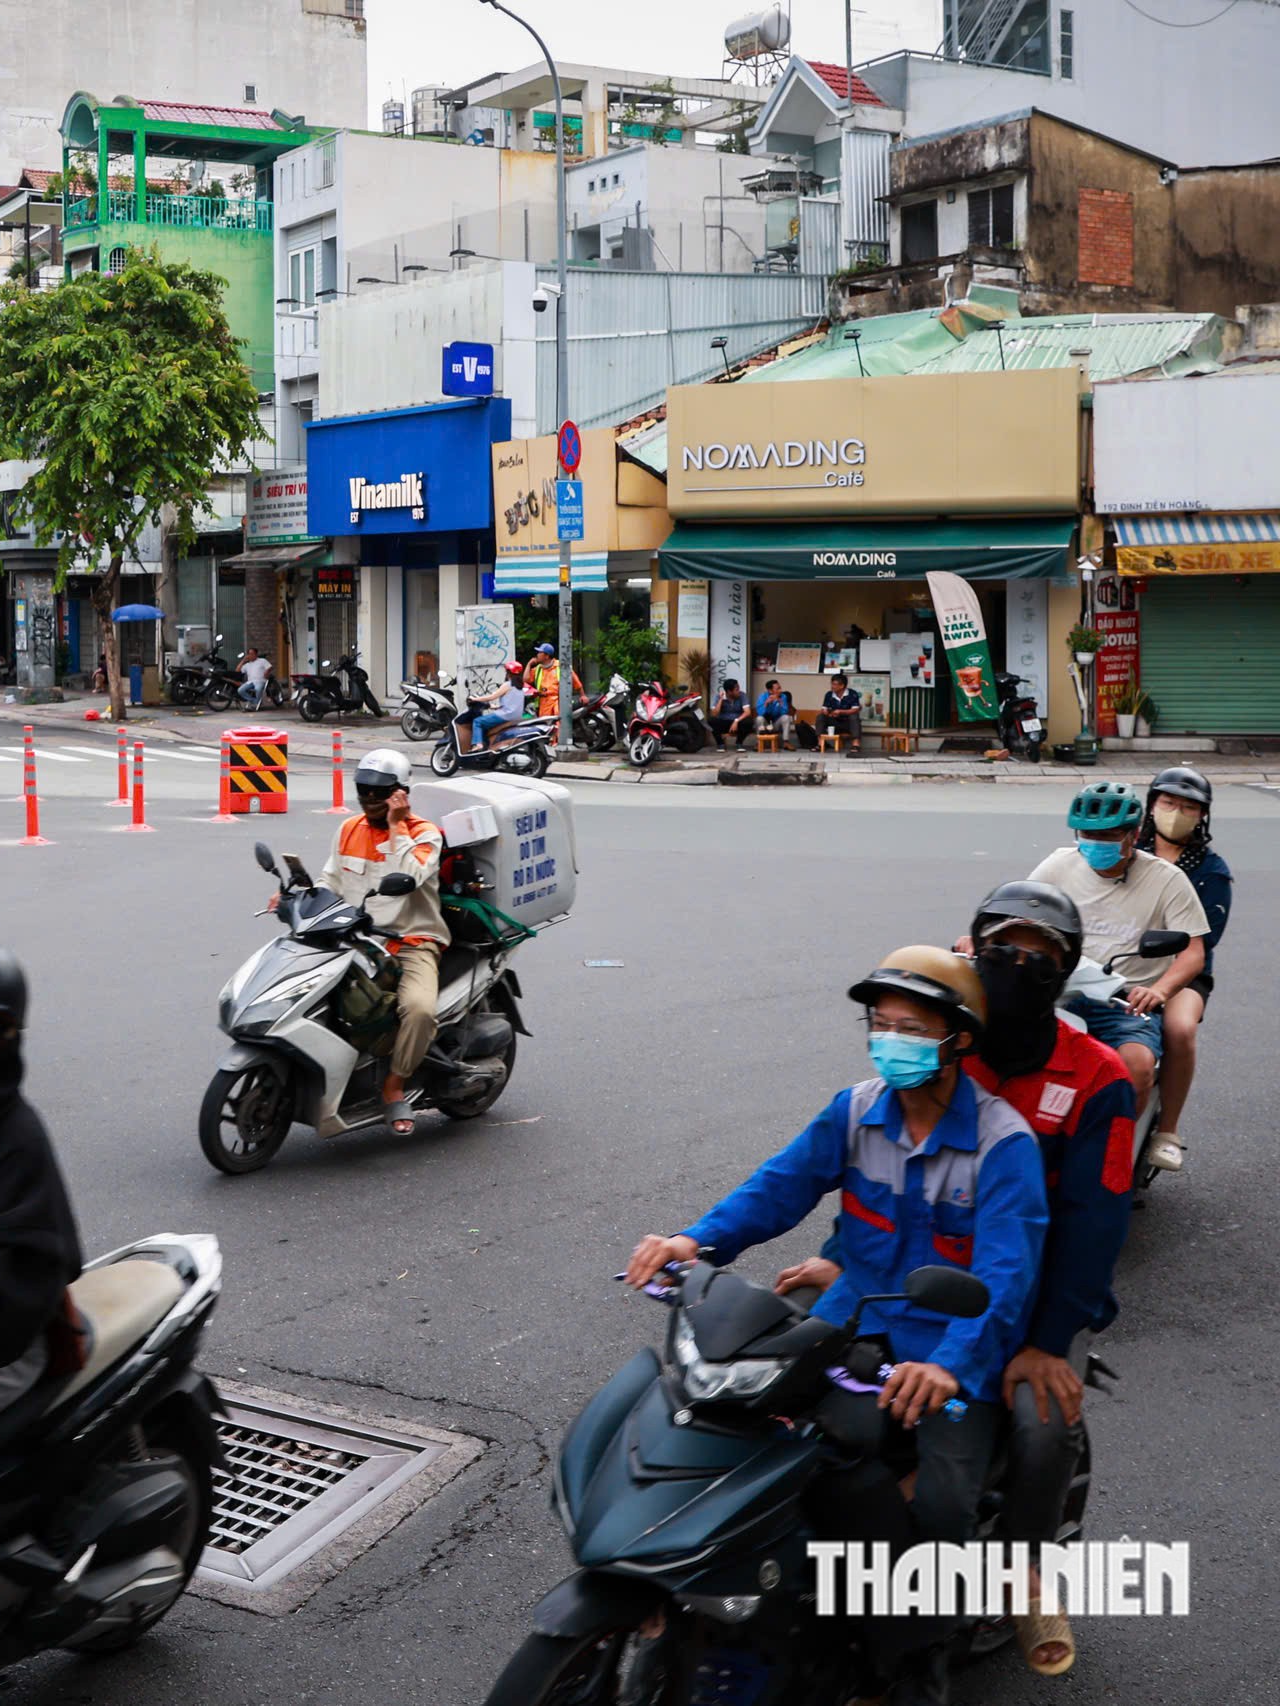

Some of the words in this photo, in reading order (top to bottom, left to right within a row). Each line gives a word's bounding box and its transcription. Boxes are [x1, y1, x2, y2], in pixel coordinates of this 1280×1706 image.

[452, 364, 462, 373] EST
[463, 357, 478, 382] V
[477, 366, 490, 375] 1976
[682, 438, 865, 470] NOMADING
[824, 471, 865, 487] Café
[349, 474, 423, 510] Vinamilk
[412, 507, 424, 520] 1976
[1103, 503, 1118, 512] 192
[1120, 503, 1143, 511] ĐINH
[350, 511, 359, 523] EST
[813, 553, 896, 566] NOMADING
[1238, 551, 1272, 569] XE
[877, 570, 896, 578] Café
[318, 580, 339, 593] MÁY
[341, 583, 352, 593] IN
[728, 583, 743, 627] chào
[944, 621, 975, 632] TAKE
[944, 630, 980, 641] AWAY
[728, 637, 741, 667] Xin
